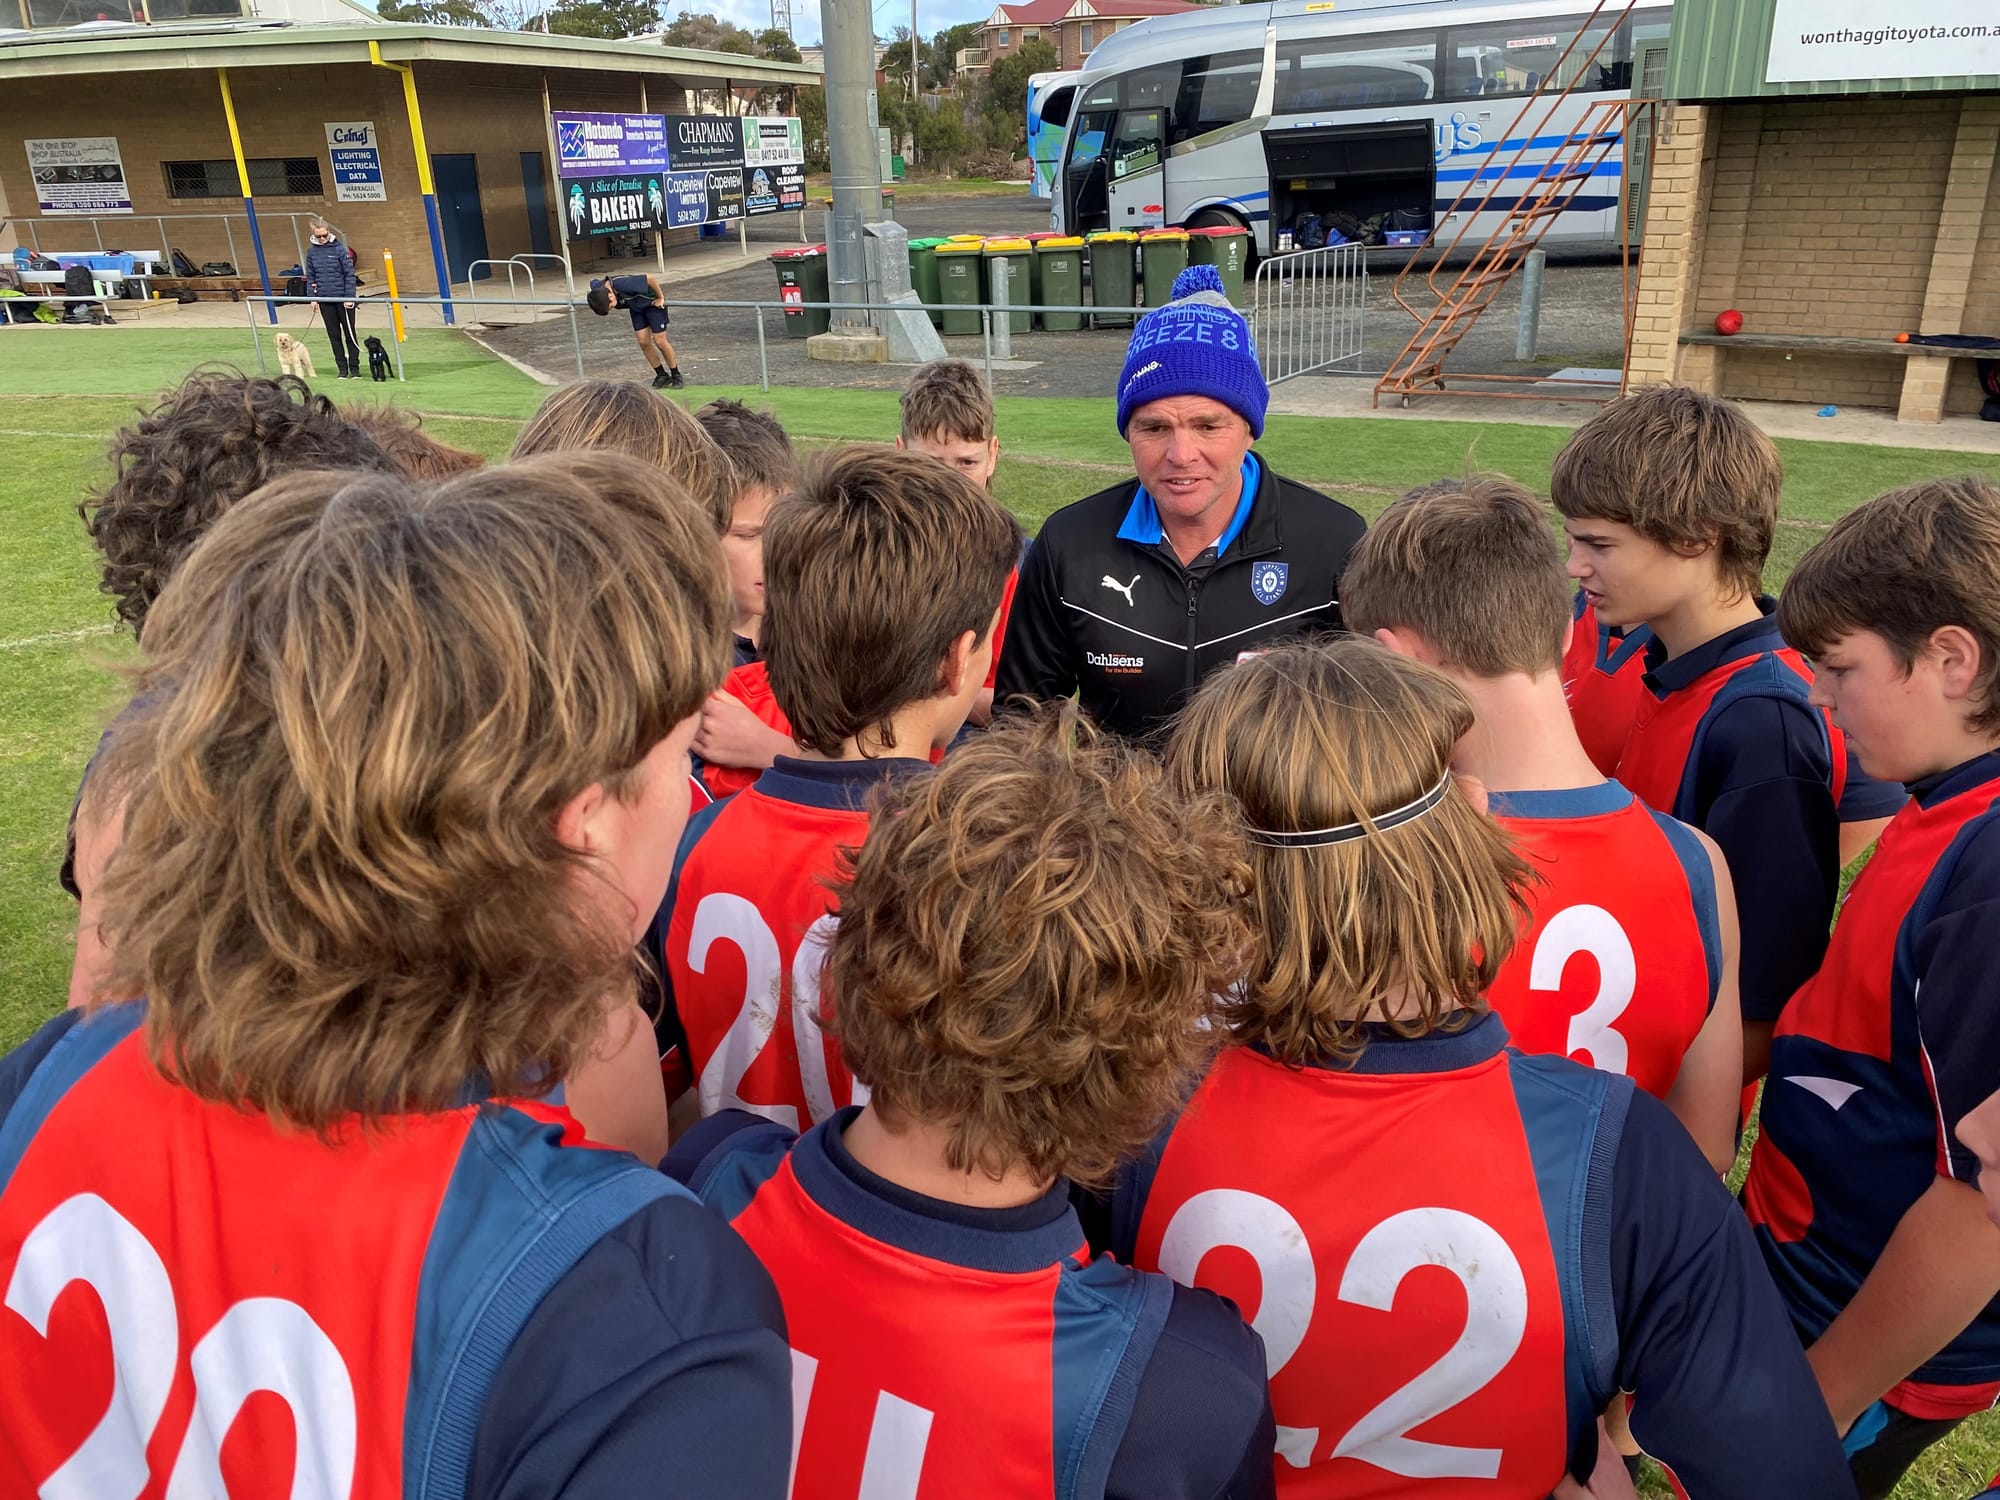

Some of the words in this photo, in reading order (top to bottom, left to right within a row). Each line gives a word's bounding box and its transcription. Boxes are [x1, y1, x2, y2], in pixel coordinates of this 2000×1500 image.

[584, 120, 624, 140] Hotondo
[678, 122, 734, 144] CHAPMANS
[31, 150, 48, 158] SHOP
[50, 150, 82, 158] AUSTRALIA
[45, 142, 60, 150] ONE
[61, 142, 77, 150] STOP
[586, 140, 620, 159] Homes
[337, 152, 372, 160] LIGHTING
[335, 162, 378, 170] ELECTRICAL
[782, 166, 798, 176] ROOF
[590, 182, 596, 193] A
[596, 178, 610, 192] Slice
[611, 178, 619, 196] of
[620, 178, 643, 191] Paradise
[667, 176, 704, 196] Capeview
[708, 171, 742, 190] Capeview
[776, 174, 804, 186] CLEANING
[682, 194, 698, 205] MITRE
[1109, 186, 1116, 195] 4
[590, 194, 644, 224] BAKERY
[1220, 329, 1240, 351] 8
[1086, 651, 1144, 667] Dahlsens
[1529, 904, 1637, 1075] 3
[1157, 1188, 1528, 1480] 22
